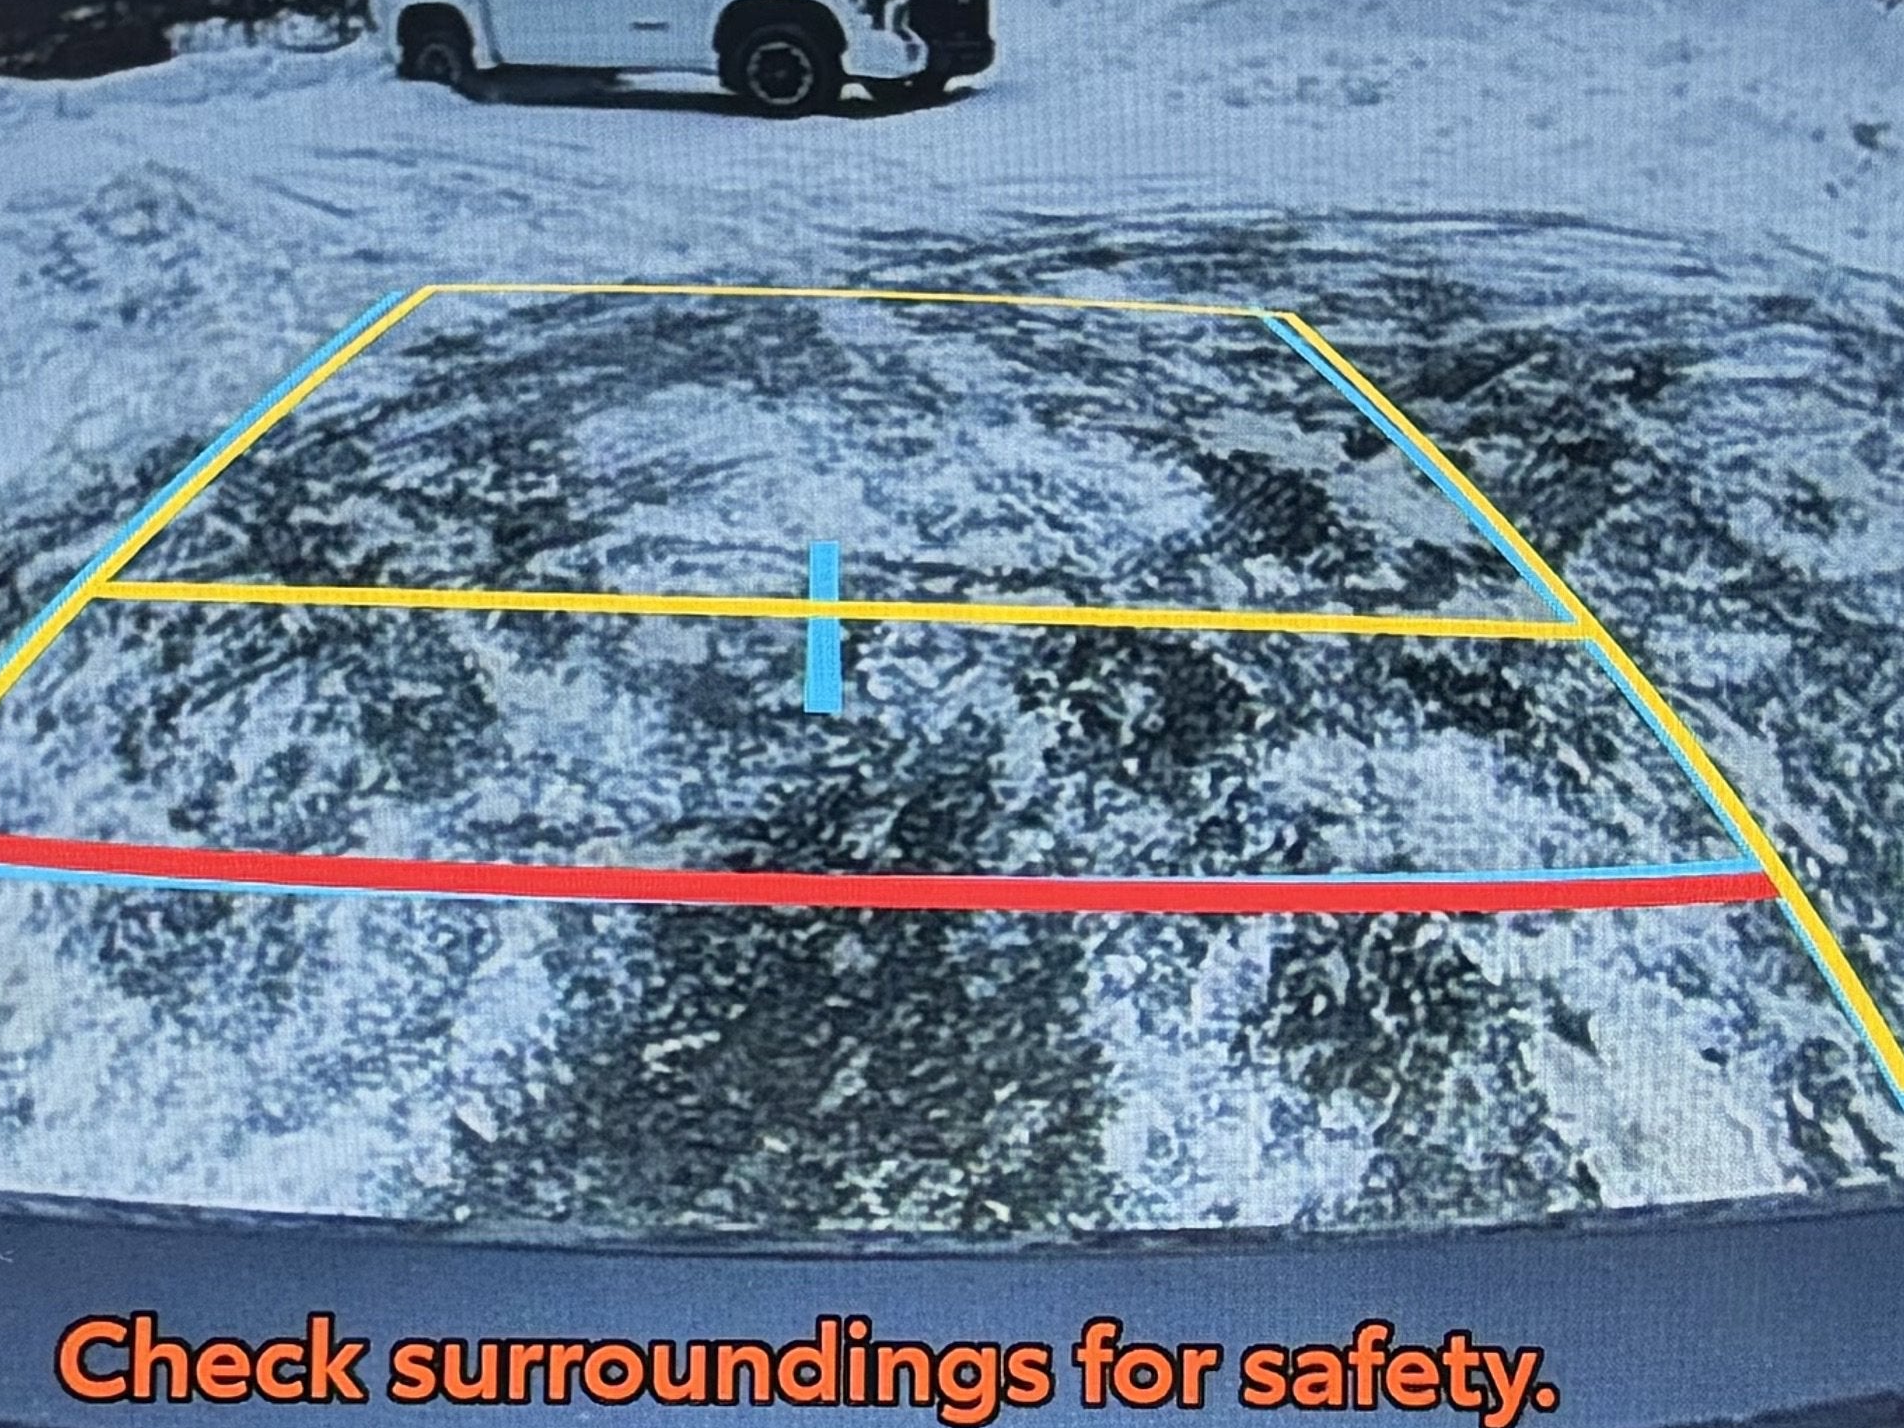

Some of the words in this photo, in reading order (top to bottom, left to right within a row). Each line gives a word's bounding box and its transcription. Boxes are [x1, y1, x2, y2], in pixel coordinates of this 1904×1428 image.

[56, 1314, 365, 1404] Check
[391, 1315, 1053, 1428] surroundings
[1075, 1319, 1217, 1407] for
